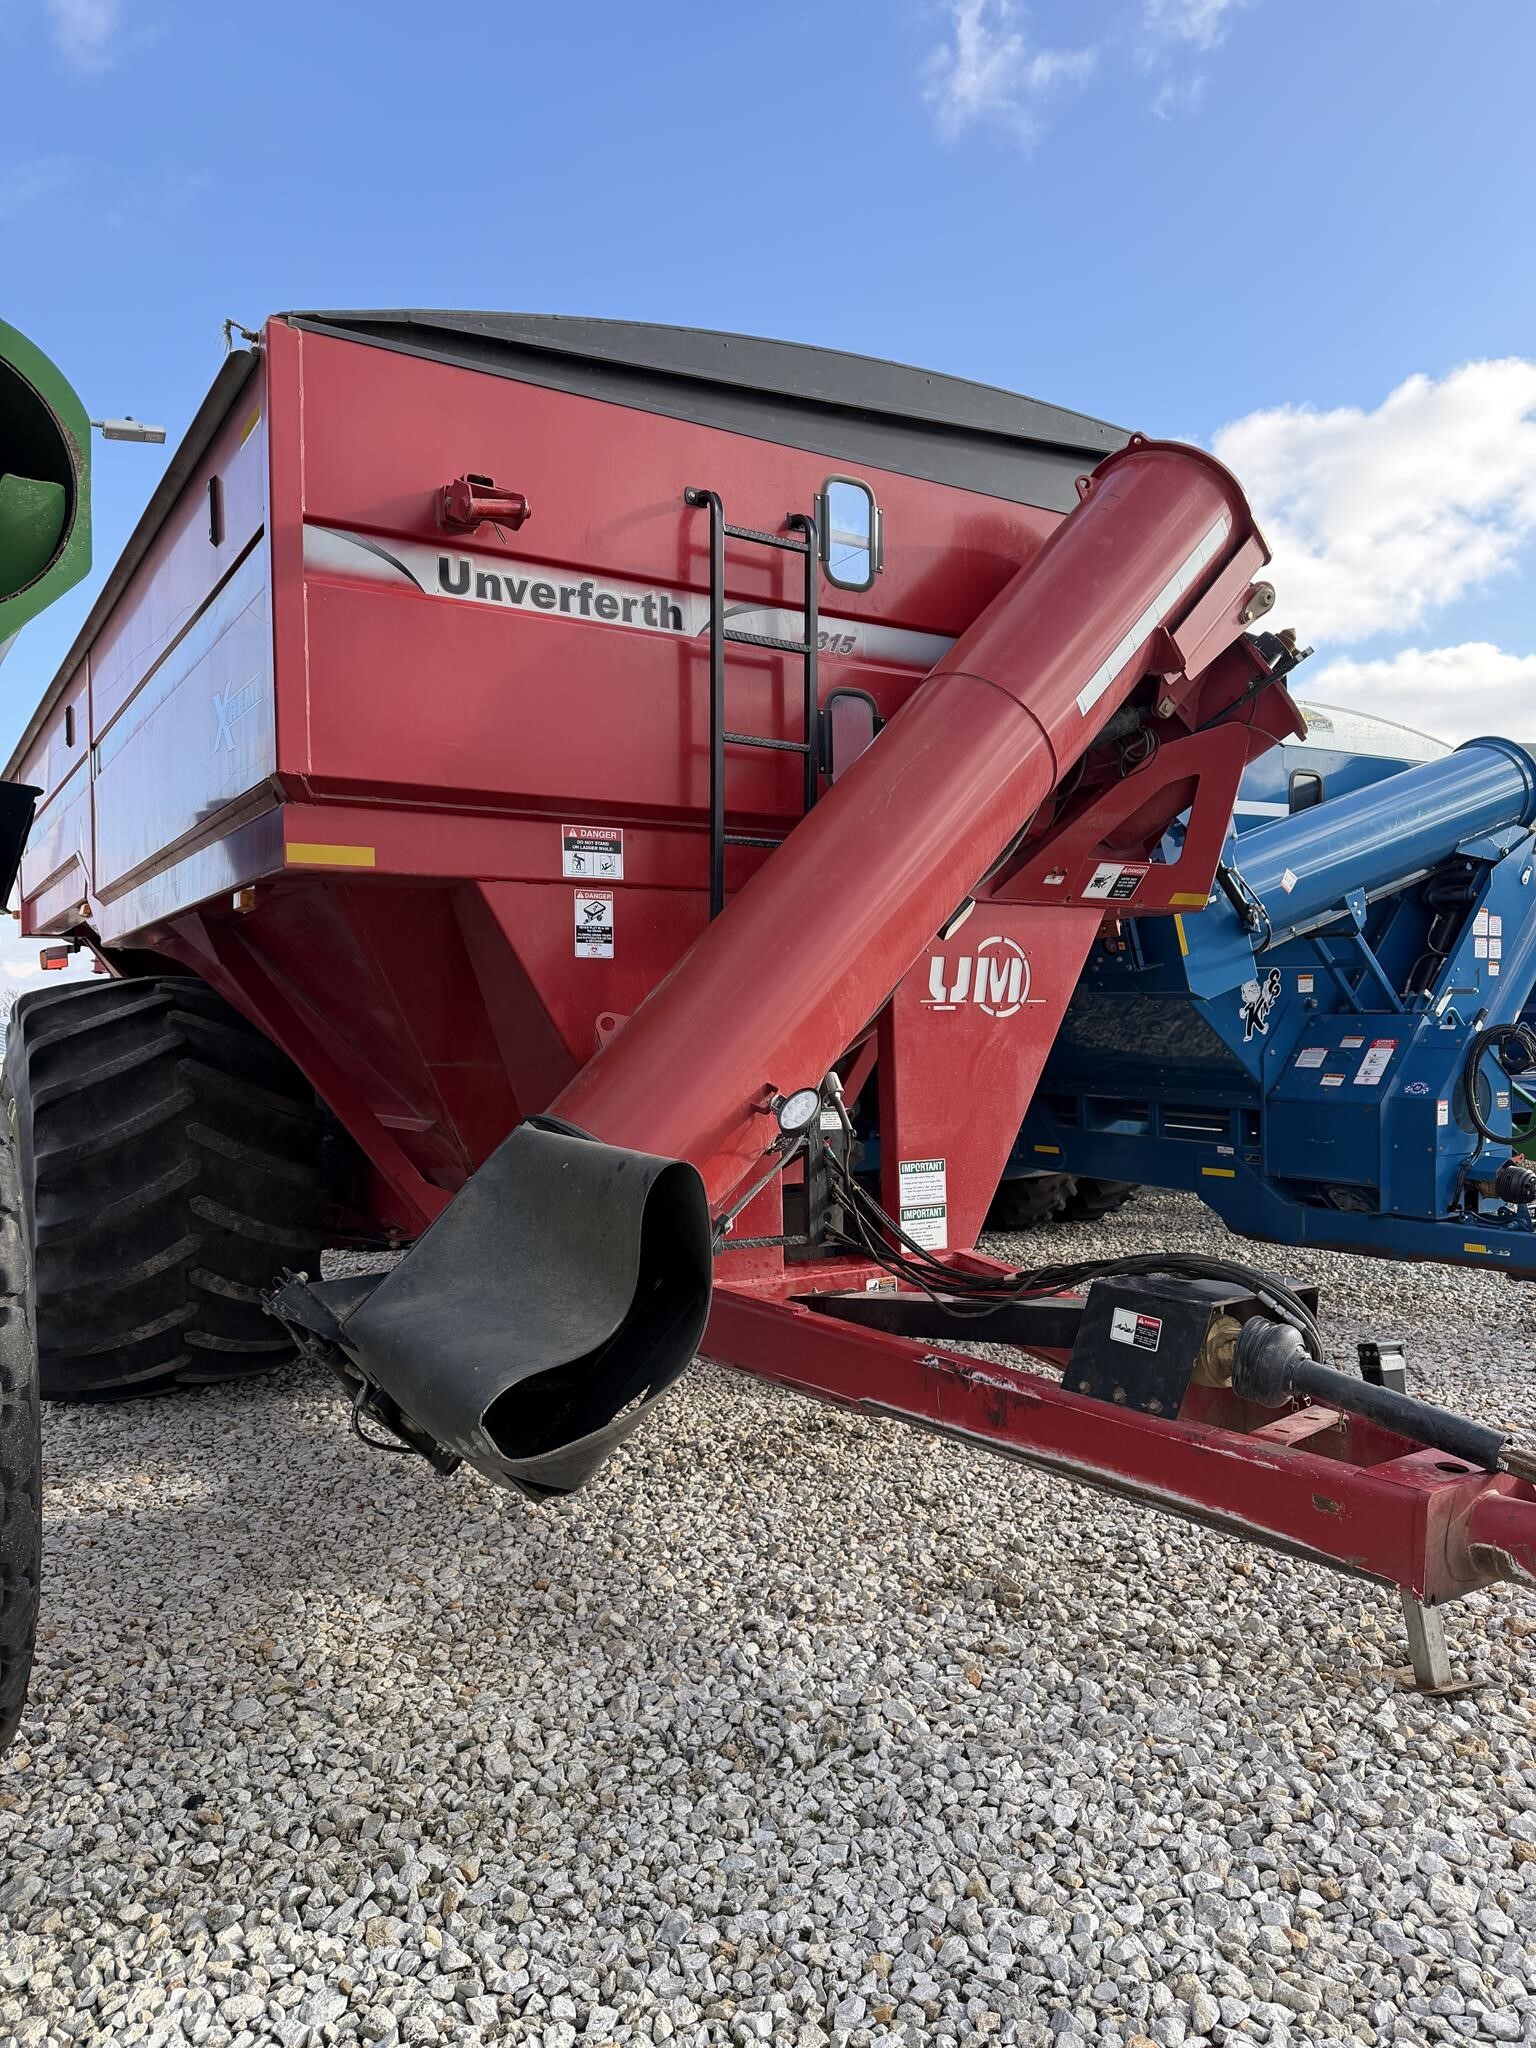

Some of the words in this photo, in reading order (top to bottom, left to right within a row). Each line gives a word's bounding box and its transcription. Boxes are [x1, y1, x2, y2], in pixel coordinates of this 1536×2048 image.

[438, 556, 684, 631] Unverferth
[817, 631, 857, 654] 315
[580, 830, 616, 839] DANGER
[584, 892, 611, 900] DANGER
[902, 1162, 942, 1173] IMPORTANT
[904, 1208, 942, 1219] IMPORTANT
